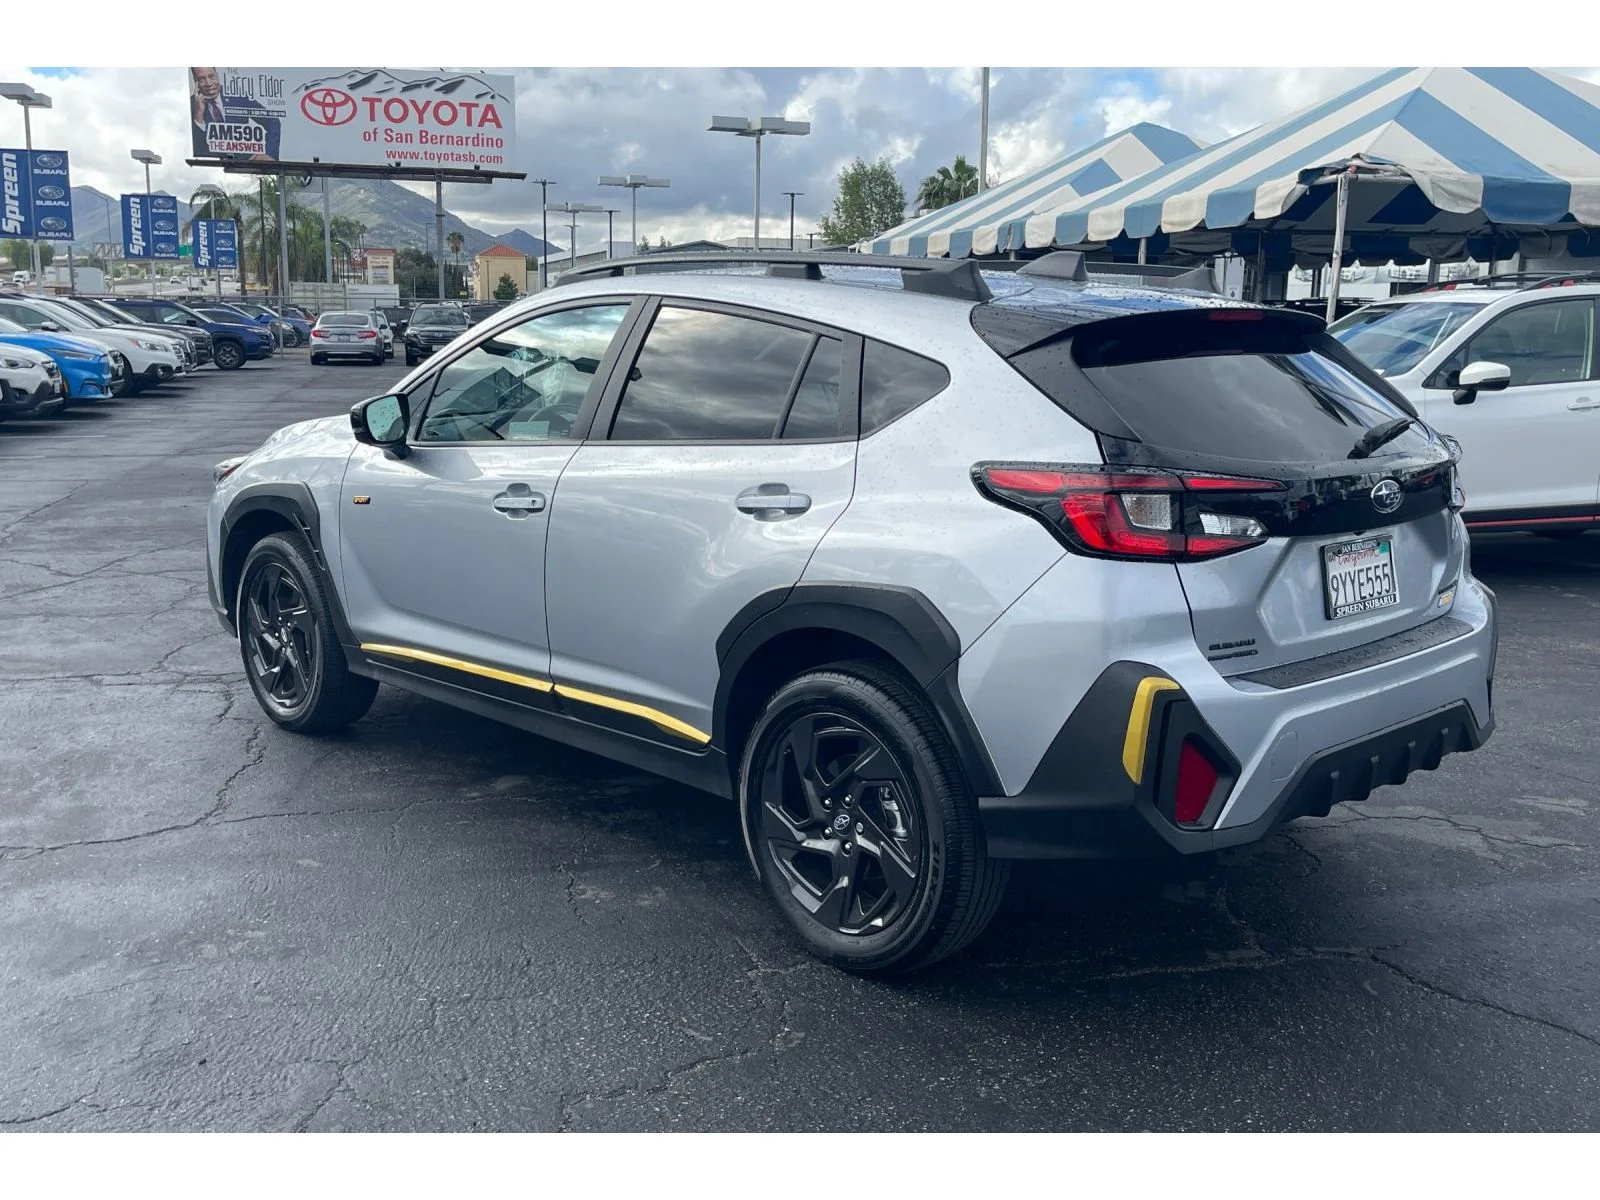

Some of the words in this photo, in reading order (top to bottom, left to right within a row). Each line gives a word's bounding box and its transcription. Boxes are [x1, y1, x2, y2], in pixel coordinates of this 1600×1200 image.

[223, 73, 254, 100] Larry
[258, 74, 285, 98] Elder
[362, 97, 502, 129] TOYOTA
[208, 125, 263, 142] AM590
[363, 127, 379, 142] of
[384, 128, 413, 144] San
[419, 129, 504, 149] Bernardino
[386, 150, 503, 164] www.toyotasb.com
[33, 168, 67, 176] SUBARU
[2, 152, 25, 235] Spreen
[129, 197, 146, 256] Spreen
[198, 221, 212, 267] Spreen
[1341, 544, 1352, 553] SAN
[1331, 562, 1391, 607] 9YYE555
[1336, 603, 1364, 617] SPREEN
[1365, 595, 1394, 610] SUBARU
